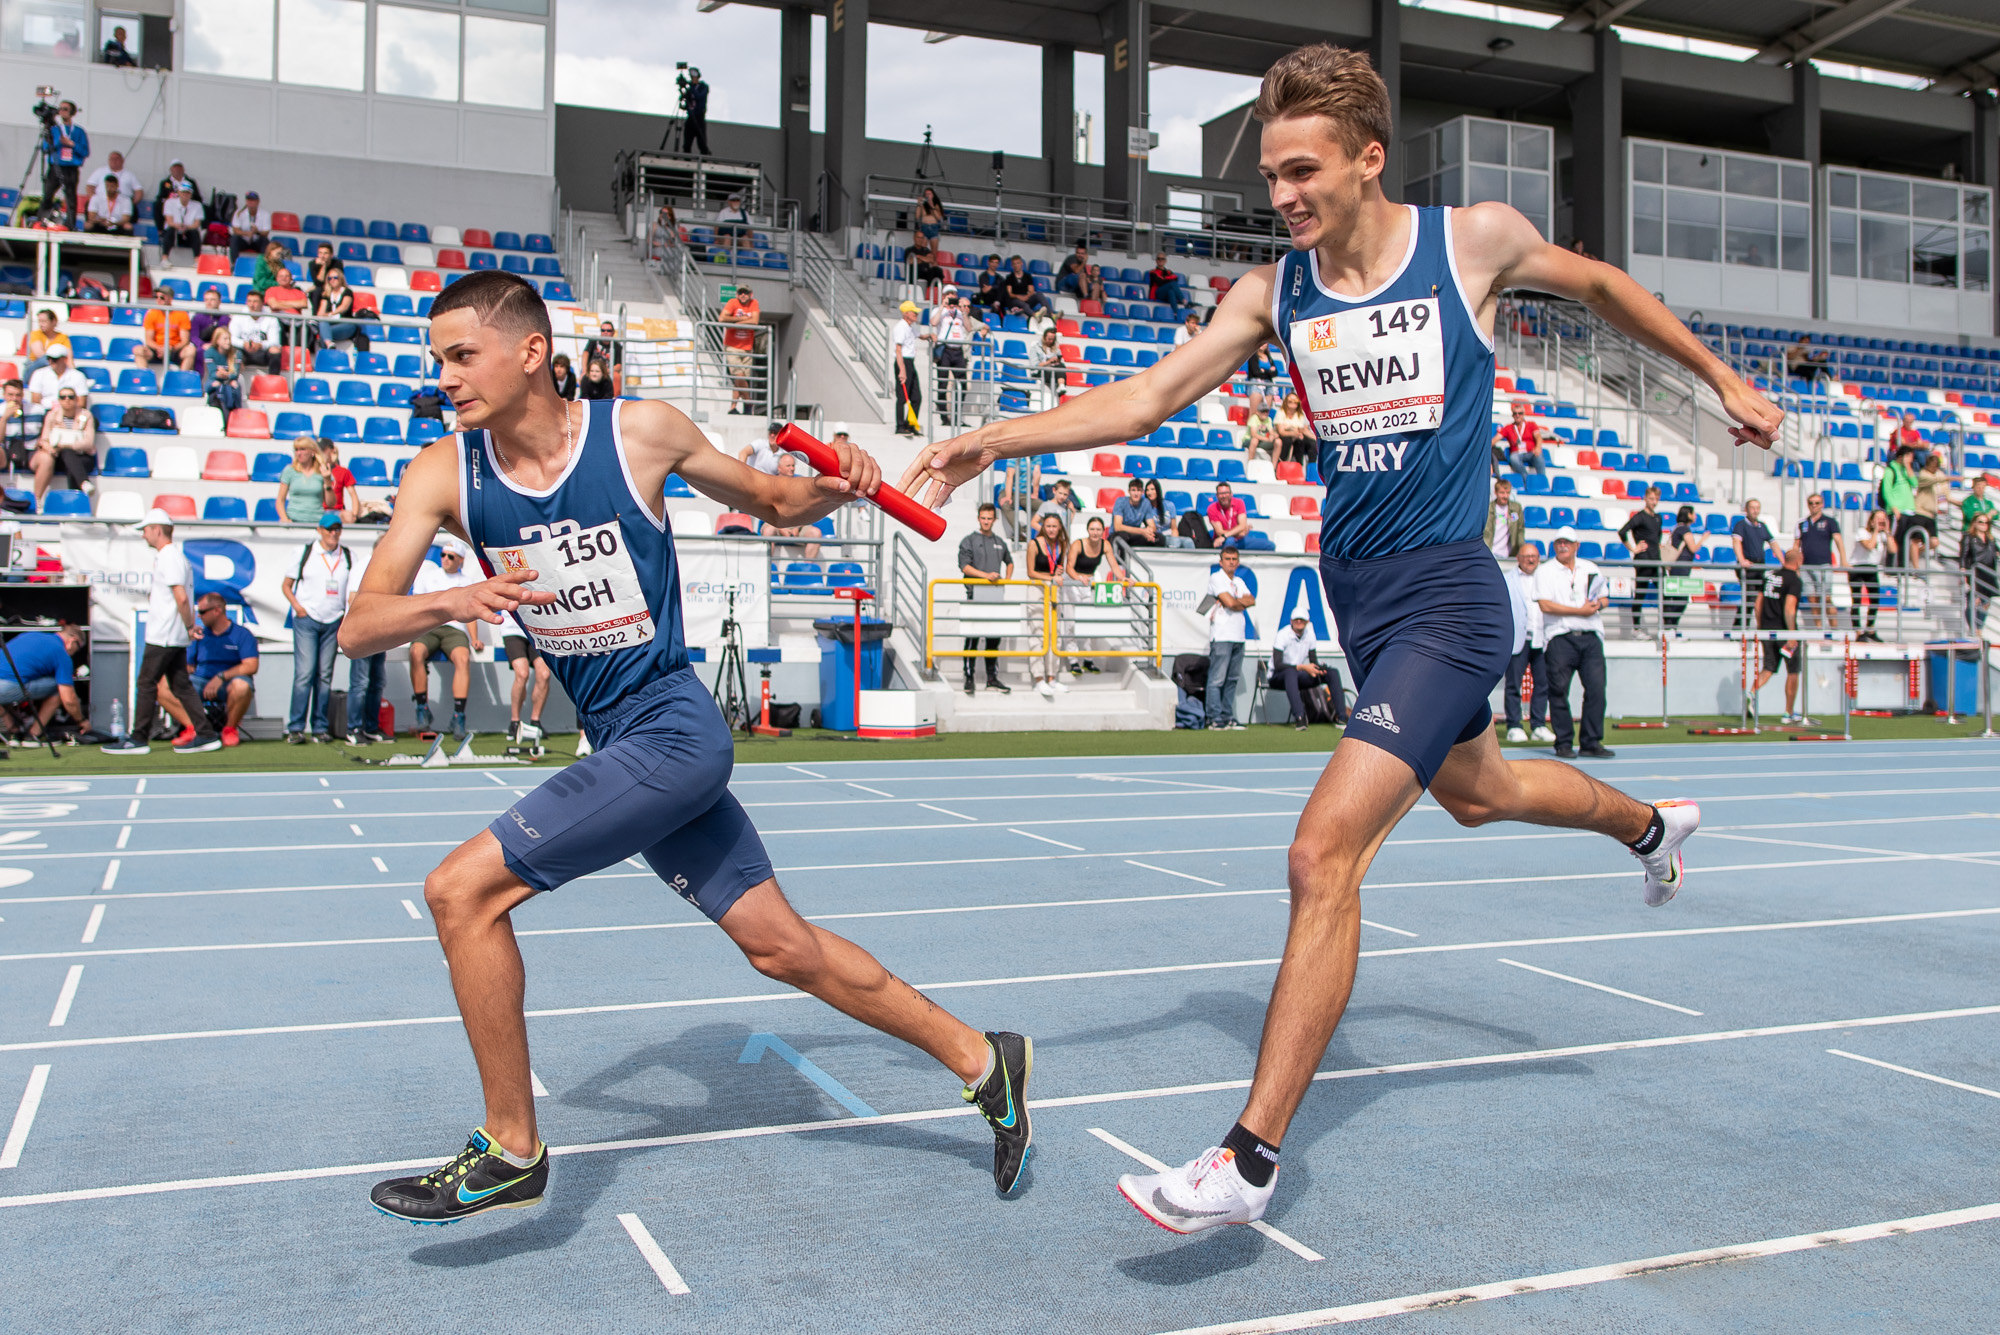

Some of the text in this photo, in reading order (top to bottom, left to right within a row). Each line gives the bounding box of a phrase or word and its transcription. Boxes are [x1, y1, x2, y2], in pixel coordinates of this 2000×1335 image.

[833, 0, 844, 32] E
[1114, 38, 1128, 72] E
[1368, 303, 1430, 338] 149
[1310, 338, 1336, 350] PZLA
[1317, 352, 1420, 395] REWAJ
[1313, 394, 1442, 420] PZLA MISTRZOSTWA POLSKI U20
[1321, 411, 1418, 437] RADOM 2022
[472, 448, 482, 490] COLO
[1335, 440, 1409, 472] ŻARY
[557, 529, 618, 568] 150
[1096, 584, 1123, 604] A-8
[596, 617, 628, 631] POLSKI
[629, 611, 648, 623] U20
[537, 631, 628, 651] RADOM 2022
[1354, 711, 1401, 734] adidas
[1635, 825, 1658, 849] PUMA
